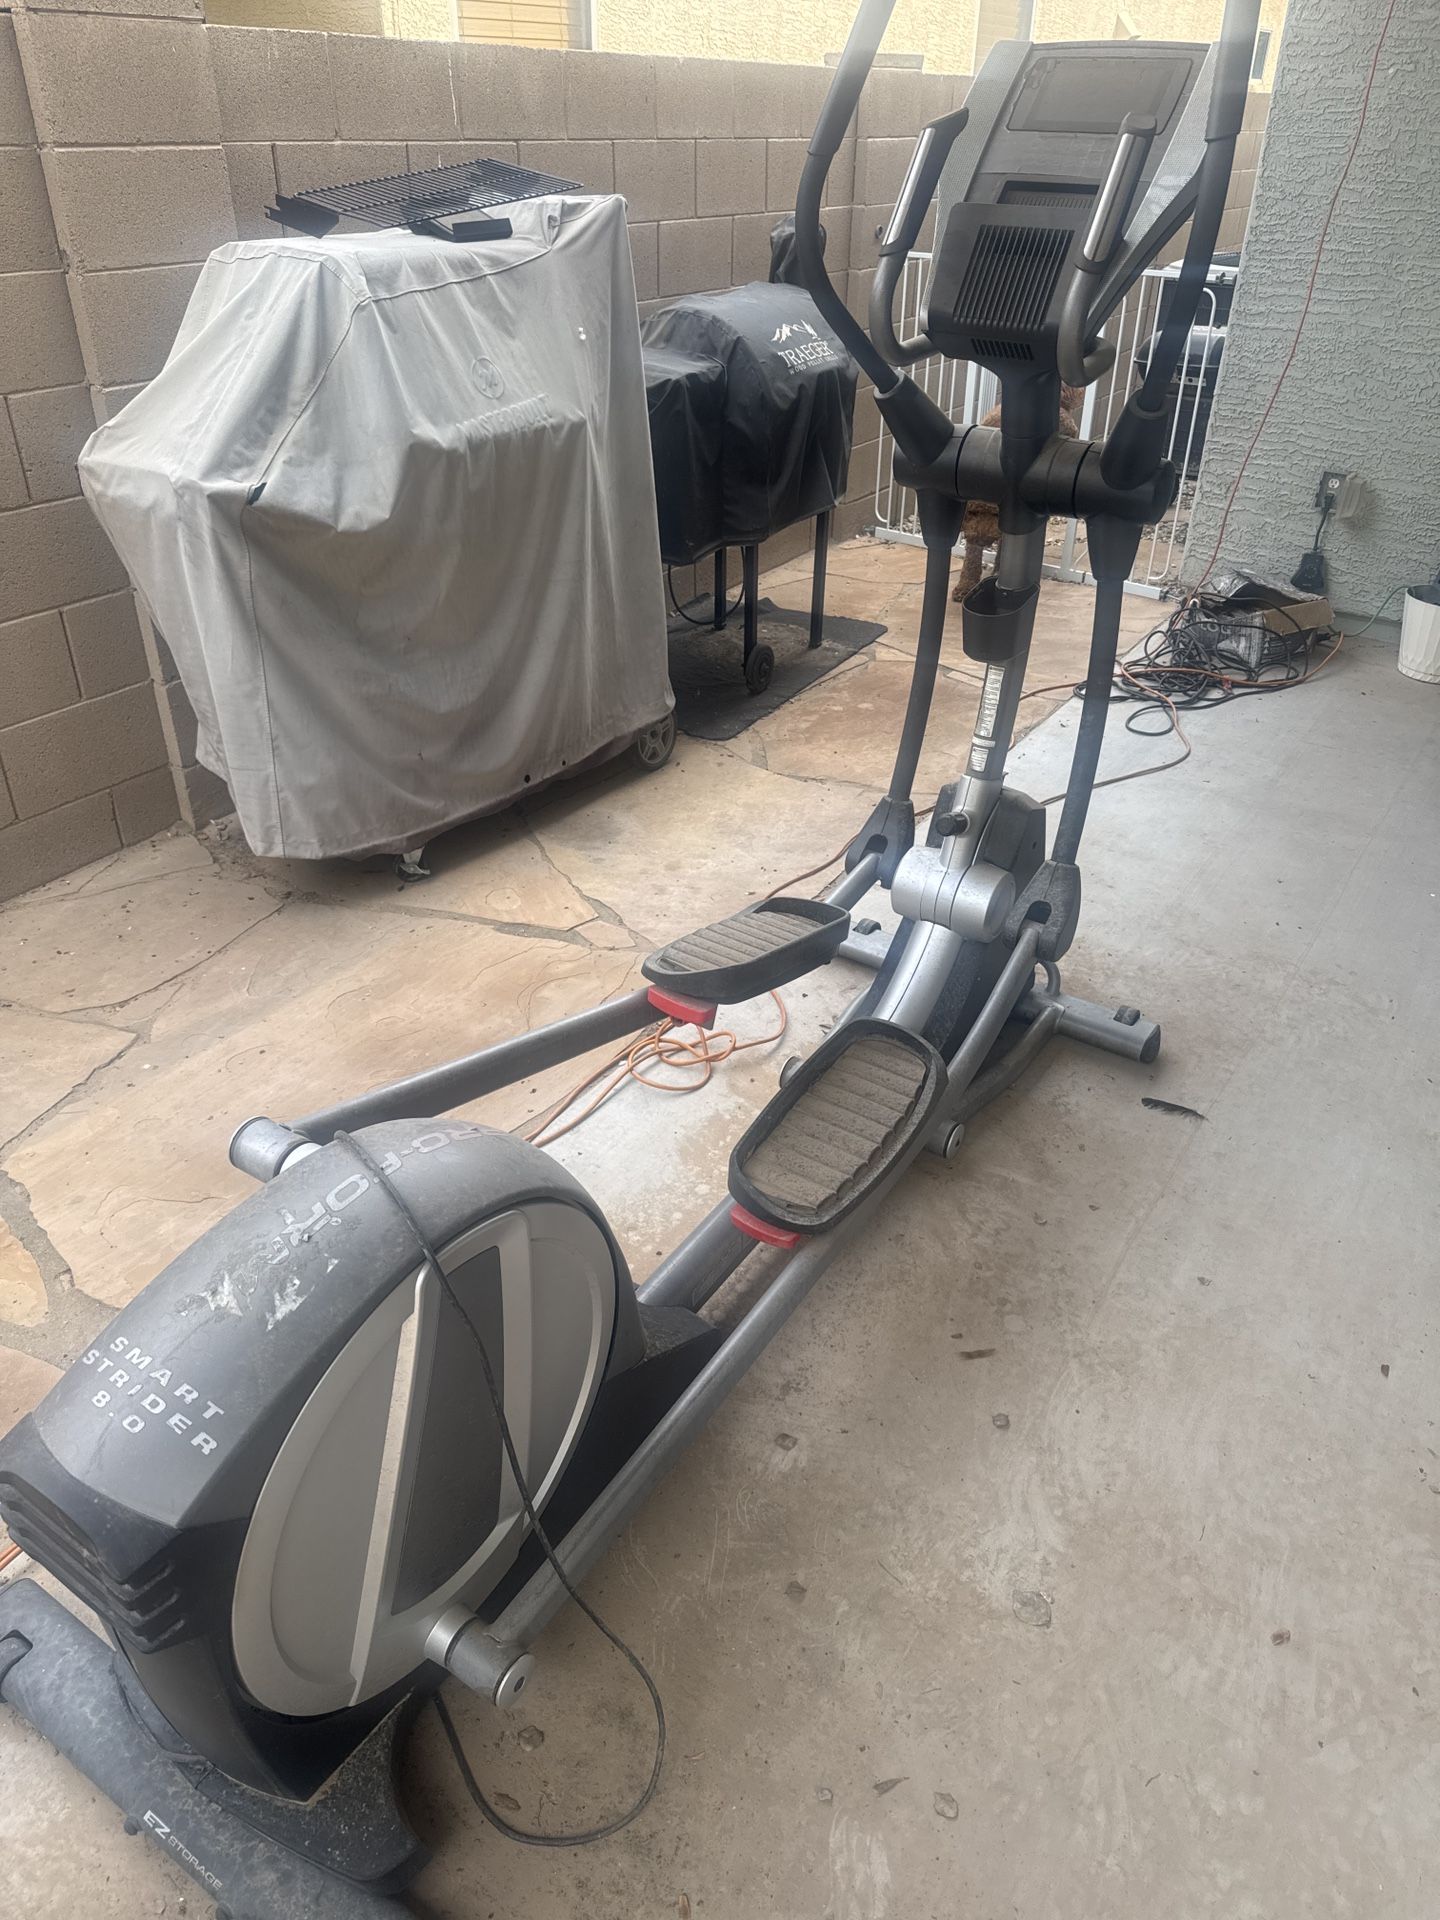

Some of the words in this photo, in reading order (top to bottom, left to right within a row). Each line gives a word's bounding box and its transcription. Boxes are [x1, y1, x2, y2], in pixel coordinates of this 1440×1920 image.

[778, 341, 835, 368] TRAEGER
[82, 1349, 218, 1456] STRIDER
[91, 1390, 146, 1434] 8.0
[110, 1336, 225, 1420] SMART
[143, 1810, 171, 1840] EZ
[167, 1835, 223, 1890] STORAGE
